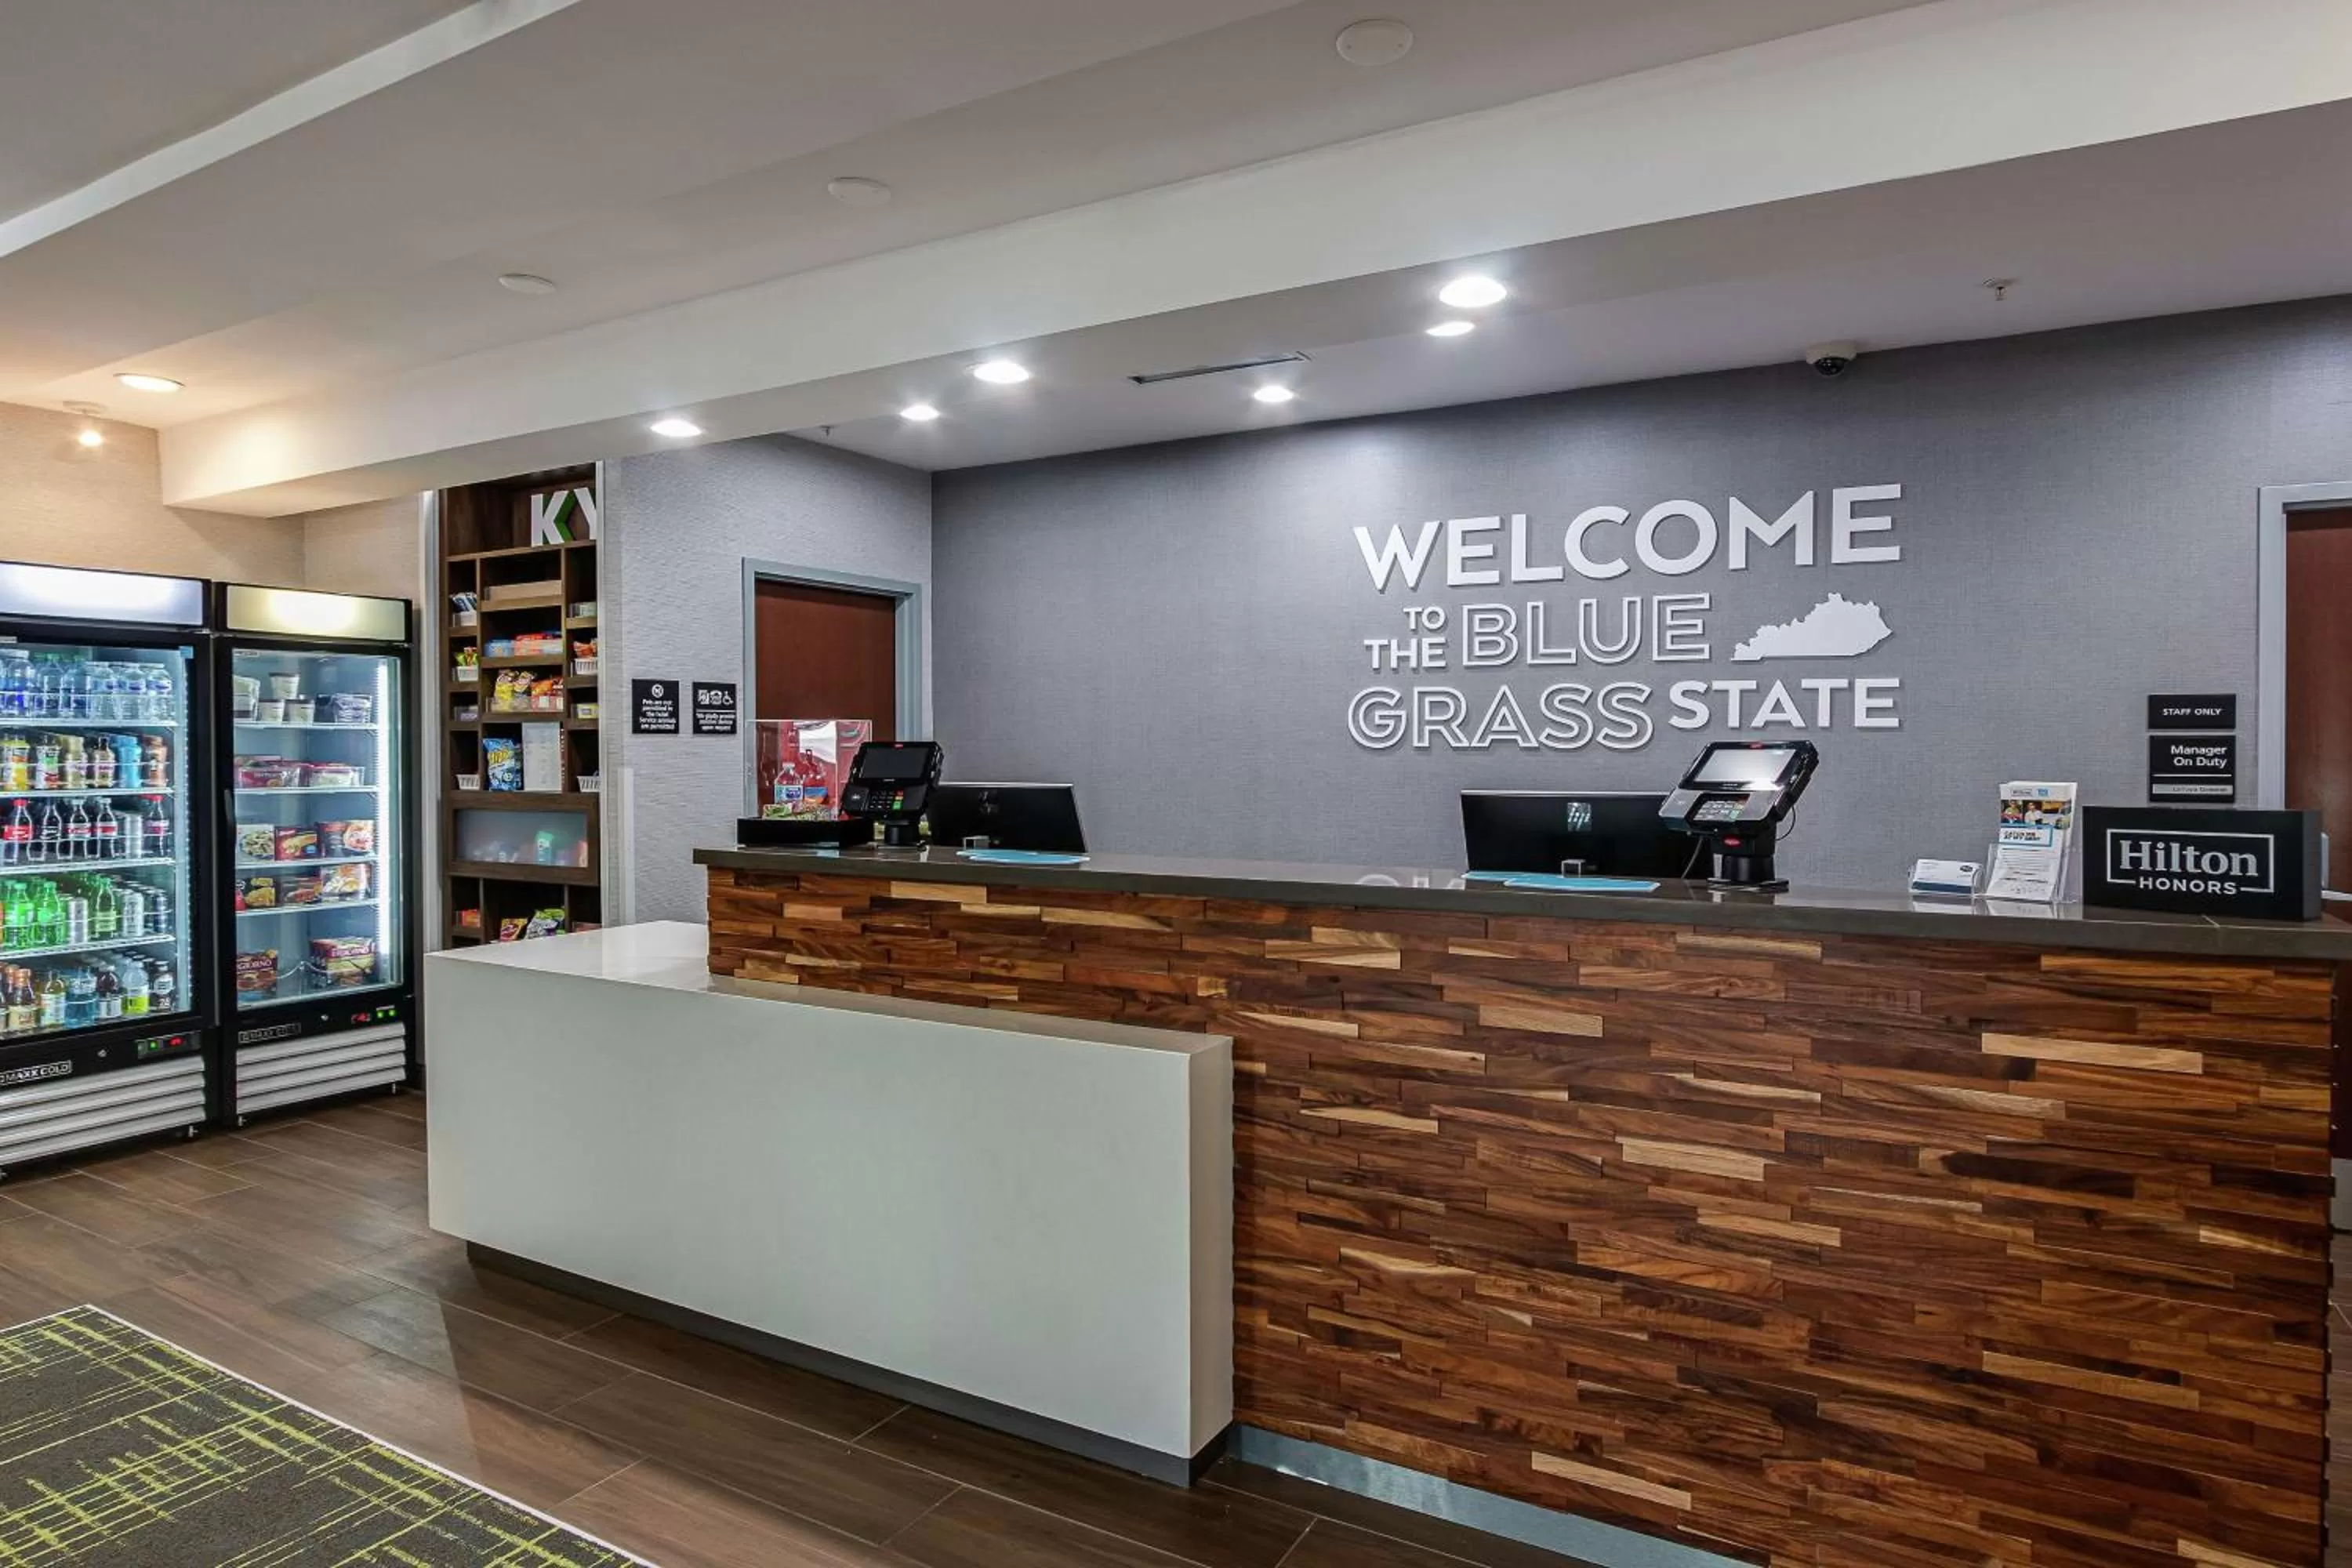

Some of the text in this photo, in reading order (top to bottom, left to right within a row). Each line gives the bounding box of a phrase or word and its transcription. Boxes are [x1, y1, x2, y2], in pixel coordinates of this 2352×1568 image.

[1353, 484, 1901, 593] WELCOME
[1403, 606, 1446, 630] TO
[1462, 592, 1711, 667] BLUE
[1364, 637, 1446, 669] THE
[1348, 678, 1900, 750] GRASS STATE
[2170, 745, 2227, 756] Manager
[2173, 757, 2227, 768] On Duty
[2119, 840, 2259, 877] Hilton
[2139, 877, 2237, 895] HONORS
[40, 1064, 68, 1076] COLD
